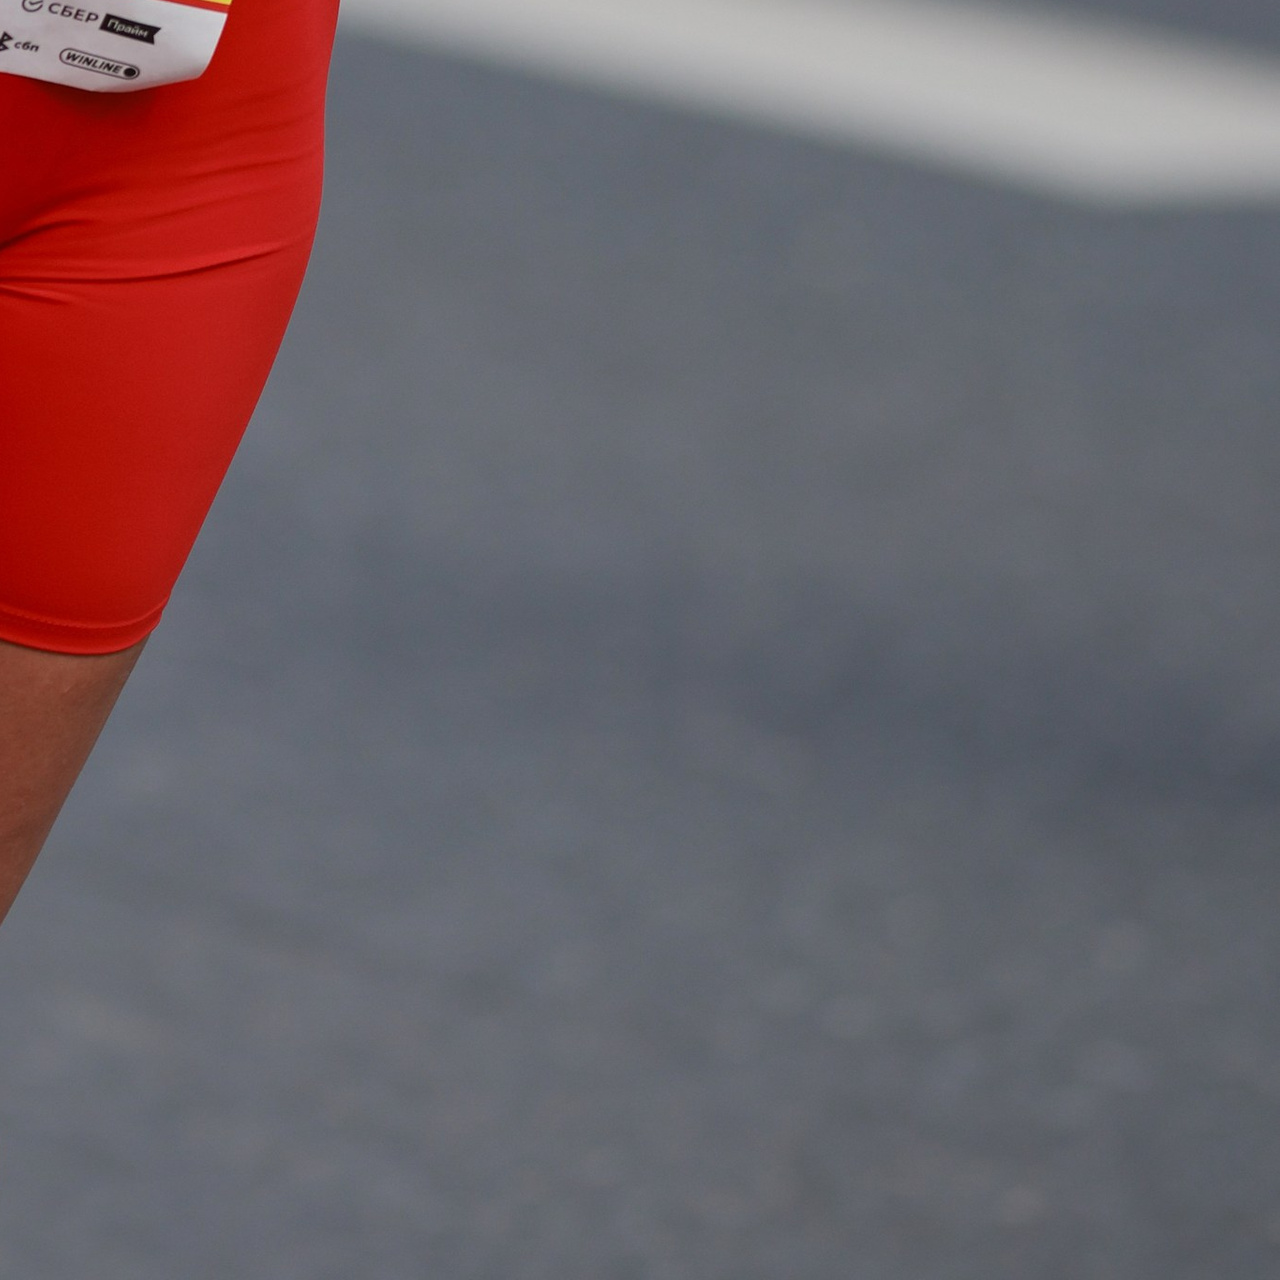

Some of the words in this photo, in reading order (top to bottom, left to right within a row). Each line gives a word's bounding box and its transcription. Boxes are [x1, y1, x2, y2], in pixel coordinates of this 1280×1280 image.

[48, 2, 99, 23] СБЕР
[106, 18, 149, 38] Прайм
[65, 51, 122, 75] WINLINE
